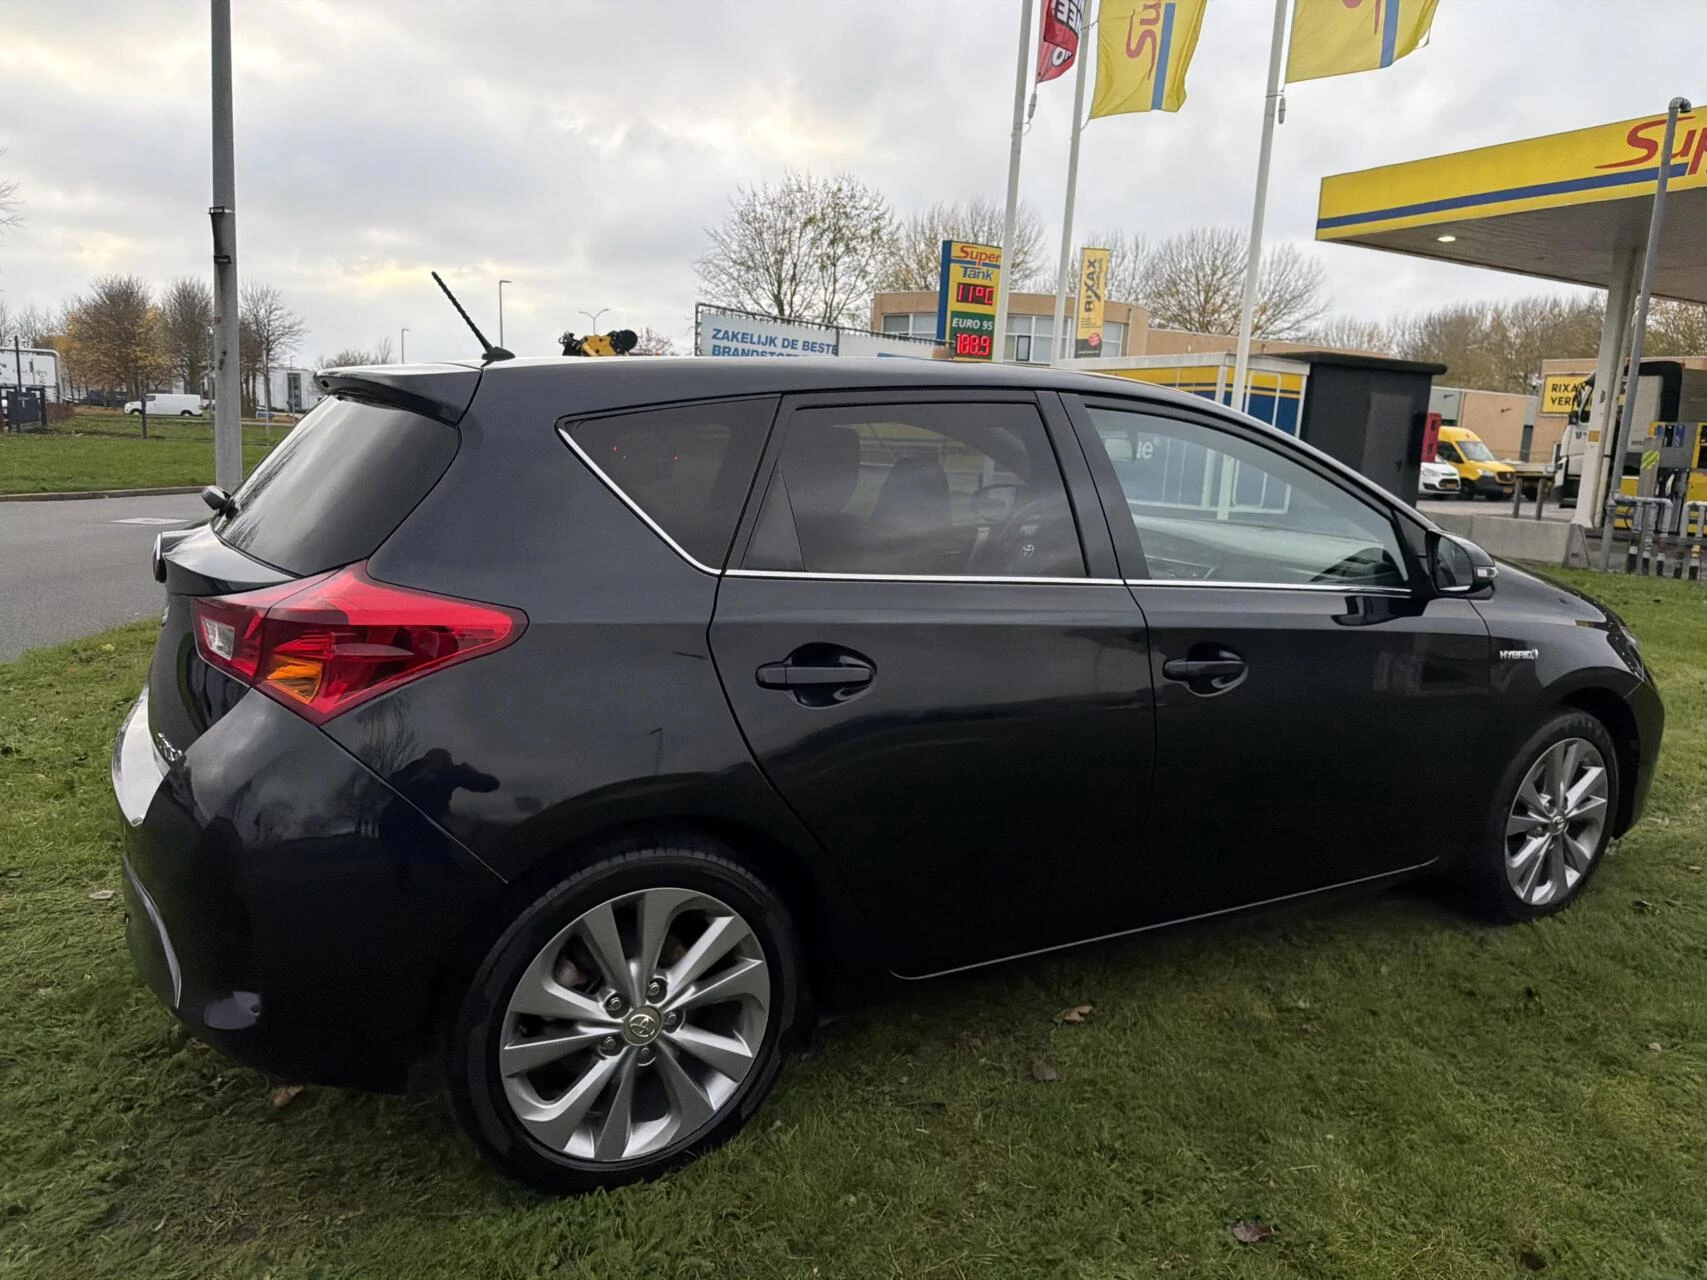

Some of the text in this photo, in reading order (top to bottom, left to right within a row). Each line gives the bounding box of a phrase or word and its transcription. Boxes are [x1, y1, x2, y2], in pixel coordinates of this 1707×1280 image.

[951, 245, 1002, 266] Super
[960, 265, 993, 281] Tank
[952, 317, 993, 331] EURO 95
[711, 328, 838, 356] ZAKELIJK DE BESTE
[1499, 650, 1535, 660] HYBRID
